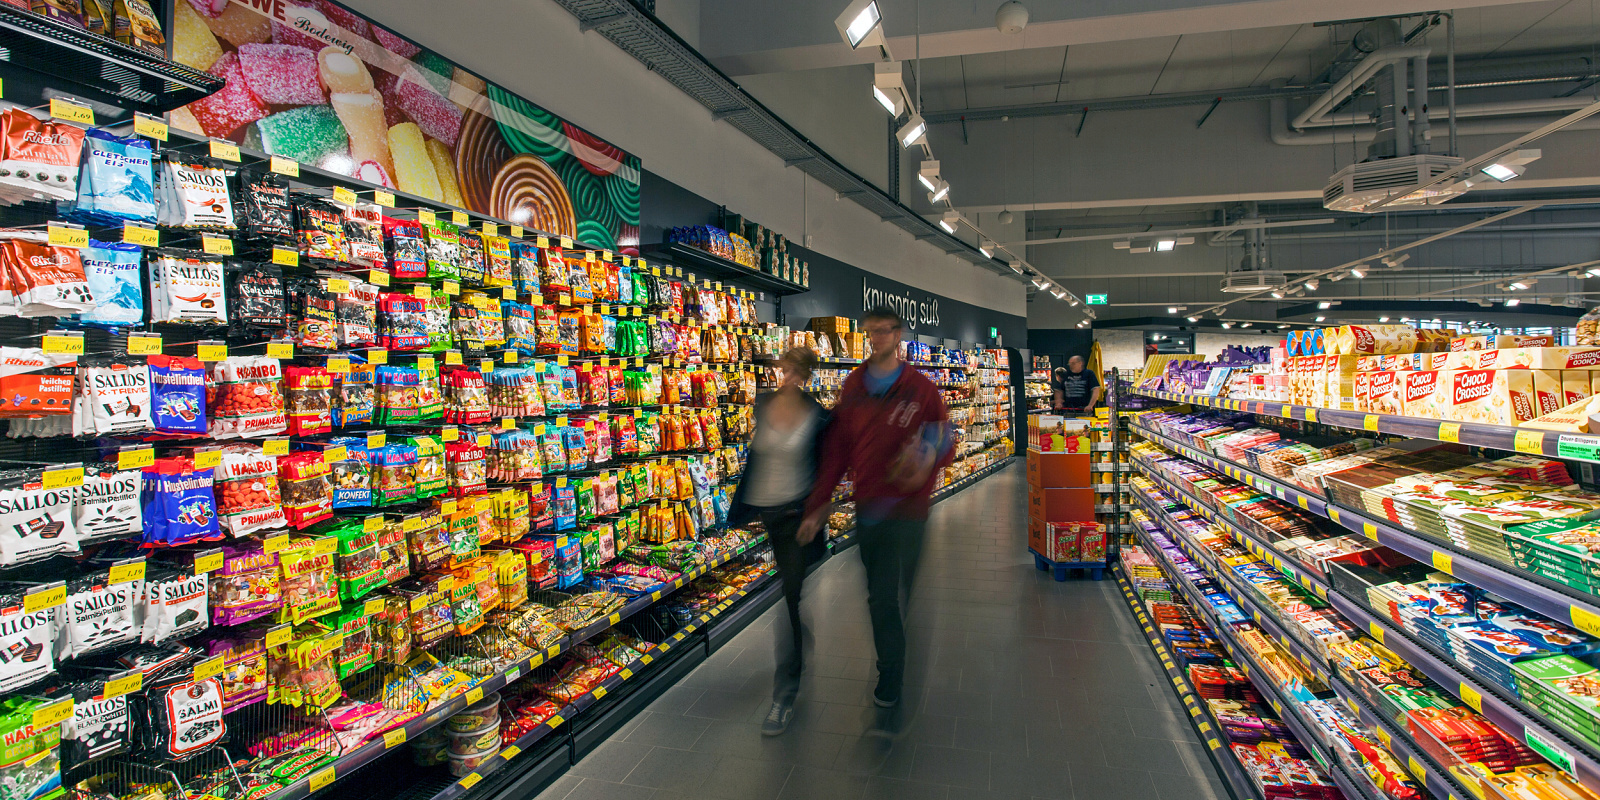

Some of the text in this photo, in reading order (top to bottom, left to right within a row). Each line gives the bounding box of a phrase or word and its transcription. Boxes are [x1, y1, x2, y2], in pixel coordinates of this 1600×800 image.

[293, 16, 355, 56] Bodewig
[23, 130, 71, 146] Rheila
[93, 149, 149, 166] GLETSCHER
[177, 170, 224, 187] SALLOS
[351, 208, 380, 222] HARIBO
[395, 225, 422, 236] HARIBO
[431, 226, 457, 240] HARIBO
[459, 235, 480, 248] HARIBO
[30, 255, 71, 267] Rheila
[83, 259, 138, 271] GLETSCHER
[401, 262, 426, 273] SALINO
[32, 271, 77, 283] Veilchen
[170, 265, 220, 281] SALLOS
[348, 288, 376, 302] HARIBO
[306, 295, 335, 311] HARIBO
[392, 301, 422, 311] HARIBO
[862, 276, 940, 330] knusprig süß
[397, 337, 429, 348] SALINO
[4, 357, 44, 367] Rheila
[1482, 352, 1496, 362] CHOCO
[1572, 358, 1597, 366] CHOCO
[236, 364, 277, 379] HARIBO
[344, 371, 373, 383] HARIBO
[393, 373, 419, 383] HARIBO
[1374, 373, 1391, 385] CHOCO
[1411, 372, 1432, 386] CHOCO
[40, 377, 72, 385] Veilchen
[95, 372, 145, 389] SALLOS
[299, 374, 331, 387] HARIBO
[463, 378, 484, 387] HARIBO
[1460, 372, 1487, 388] CHOCO
[38, 385, 71, 393] Pastillen
[1370, 383, 1394, 398] CROSSIES
[1407, 383, 1435, 400] CROSSIES
[1455, 382, 1492, 403] CROSSIES
[1513, 395, 1524, 416] CHOCO
[1521, 393, 1534, 422] CROSSIES
[244, 415, 285, 429] PRIMAVERA
[386, 451, 416, 464] HARIBO
[417, 444, 444, 456] HARIBO
[459, 450, 483, 461] HARIBO
[230, 459, 273, 476] HARIBO
[297, 462, 331, 478] HARIBO
[81, 478, 136, 498] SALLOS
[337, 490, 371, 500] KONFEKT
[559, 489, 574, 498] HARIBO
[0, 489, 71, 515] SALLOS
[240, 510, 284, 526] PRIMAVERA
[421, 514, 443, 530] ARIBO
[452, 515, 478, 529] HARIBO
[348, 532, 377, 552] HARIBO
[378, 530, 404, 547] HARIBO
[229, 553, 275, 573] HARIBO
[288, 554, 329, 575] HARIBO
[164, 578, 205, 600] SALLOS
[453, 581, 477, 600] HARIBO
[73, 589, 126, 616] SALLOS
[297, 600, 318, 612] SAURE
[427, 592, 445, 605] RIBO
[298, 599, 338, 619] BOHNEN
[342, 616, 369, 633] HARIBO
[75, 695, 125, 722] SALLOS
[178, 699, 219, 720] SALMI
[77, 716, 100, 730] BLACK
[105, 709, 126, 721] WHITE
[280, 750, 327, 776] CHERRIES
